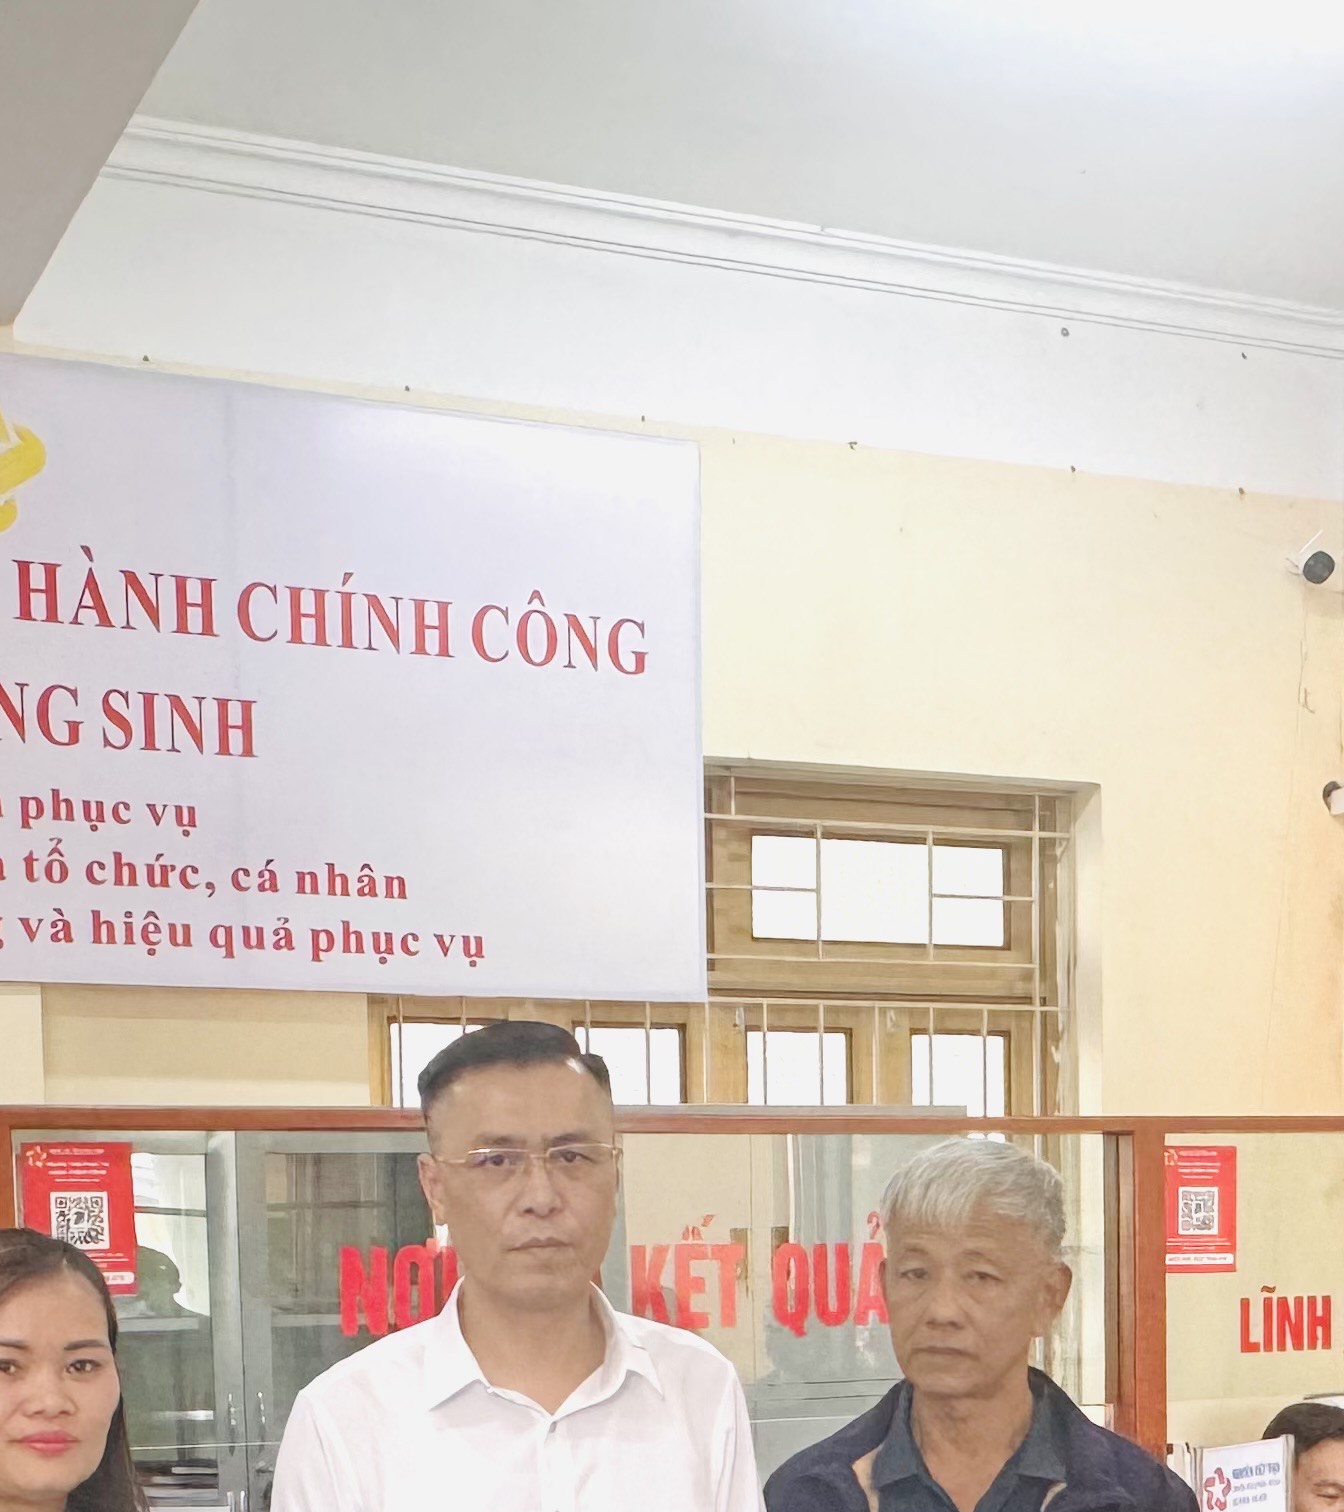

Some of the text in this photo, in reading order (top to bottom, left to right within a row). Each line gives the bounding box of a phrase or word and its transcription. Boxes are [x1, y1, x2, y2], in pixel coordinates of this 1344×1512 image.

[14, 546, 216, 637] HÀNH
[235, 572, 450, 658] CHÍNH
[470, 590, 646, 676] CÔNG
[100, 688, 256, 758] SINH
[19, 787, 130, 833] phục
[147, 803, 198, 836] vụ
[22, 839, 70, 885] tổ
[84, 850, 216, 896] chức,
[230, 860, 279, 895] cá
[295, 863, 407, 900] nhân
[19, 908, 74, 945] và
[90, 909, 193, 957] hiệu
[208, 922, 296, 960] quả
[309, 920, 419, 965] phục
[435, 934, 485, 967] vụ
[630, 1214, 744, 1330] KẾT
[1240, 1285, 1332, 1353] LĨNH
